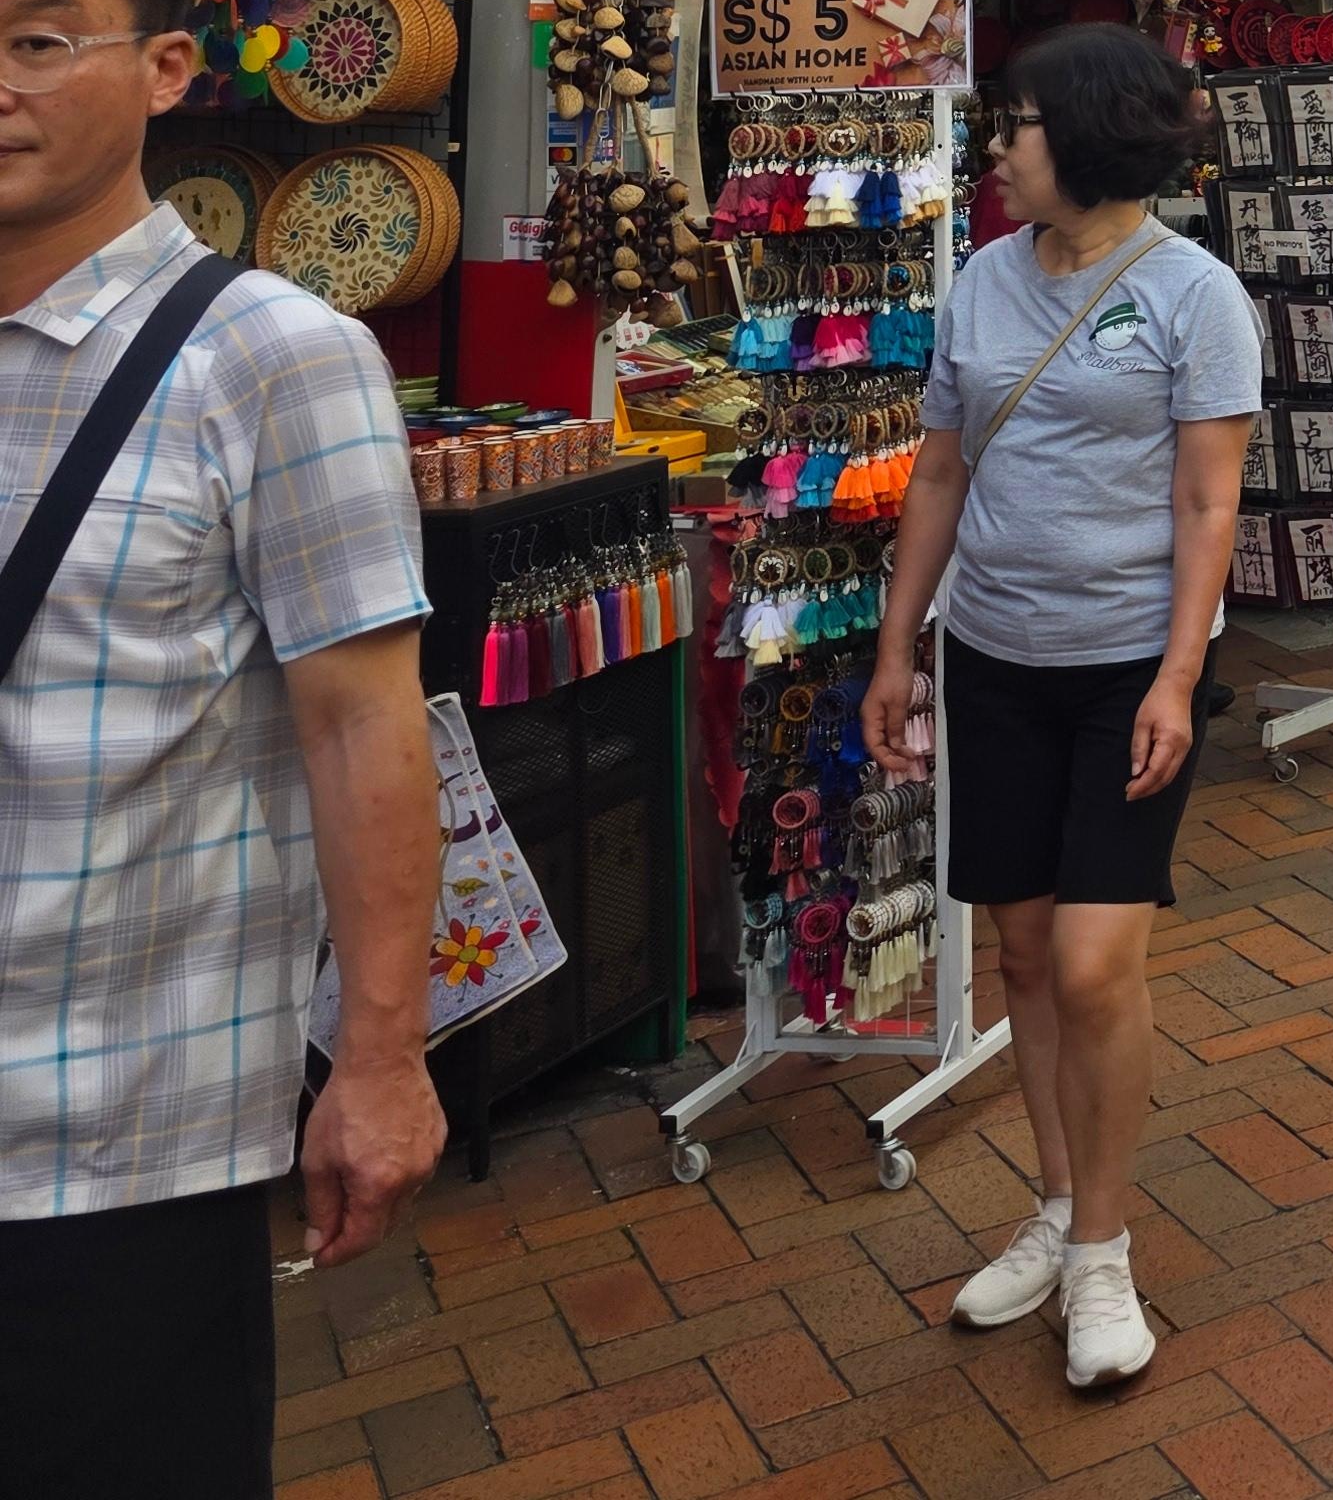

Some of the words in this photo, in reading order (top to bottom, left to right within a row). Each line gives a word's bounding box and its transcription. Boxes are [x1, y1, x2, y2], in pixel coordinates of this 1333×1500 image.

[721, 51, 786, 72] ASIAN
[795, 47, 867, 68] HOME
[743, 77, 785, 86] HANDMADE
[787, 76, 809, 85] WITH
[811, 75, 834, 84] LOVE
[1076, 351, 1147, 372] Malbon
